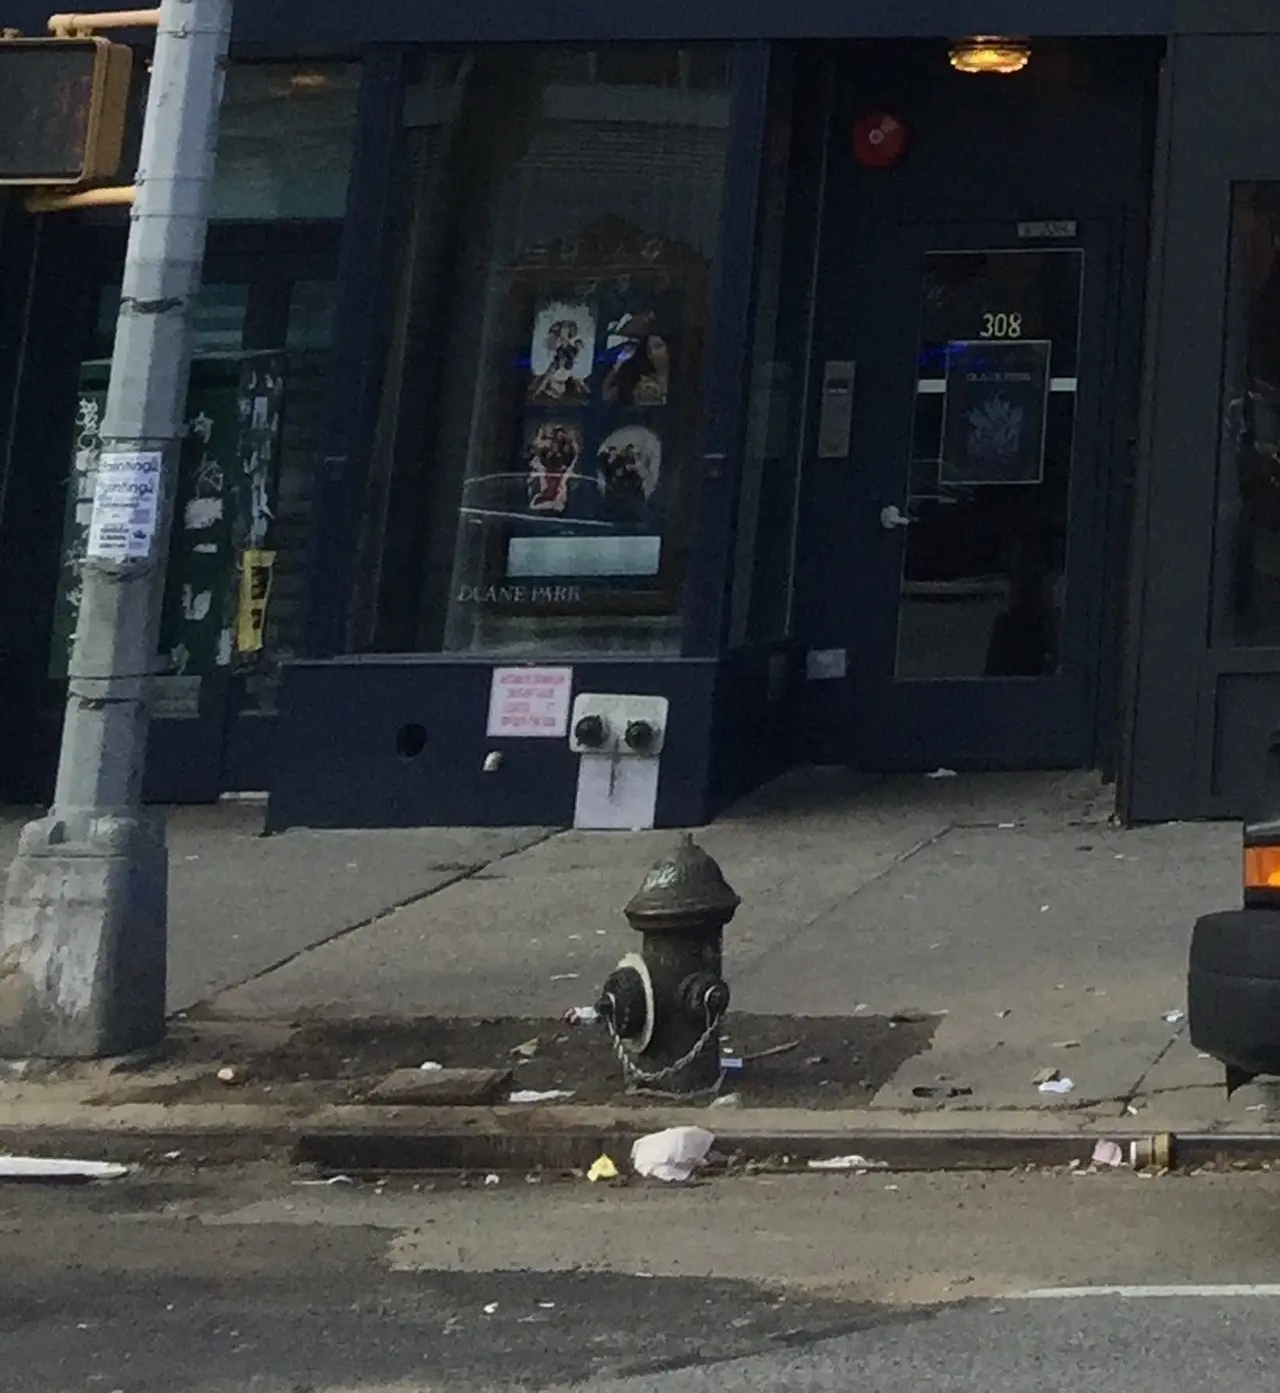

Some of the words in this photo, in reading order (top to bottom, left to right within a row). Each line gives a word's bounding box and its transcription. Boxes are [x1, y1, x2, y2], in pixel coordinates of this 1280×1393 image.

[980, 312, 1023, 338] 308
[457, 585, 526, 603] DUANE
[531, 585, 581, 603] PARK
